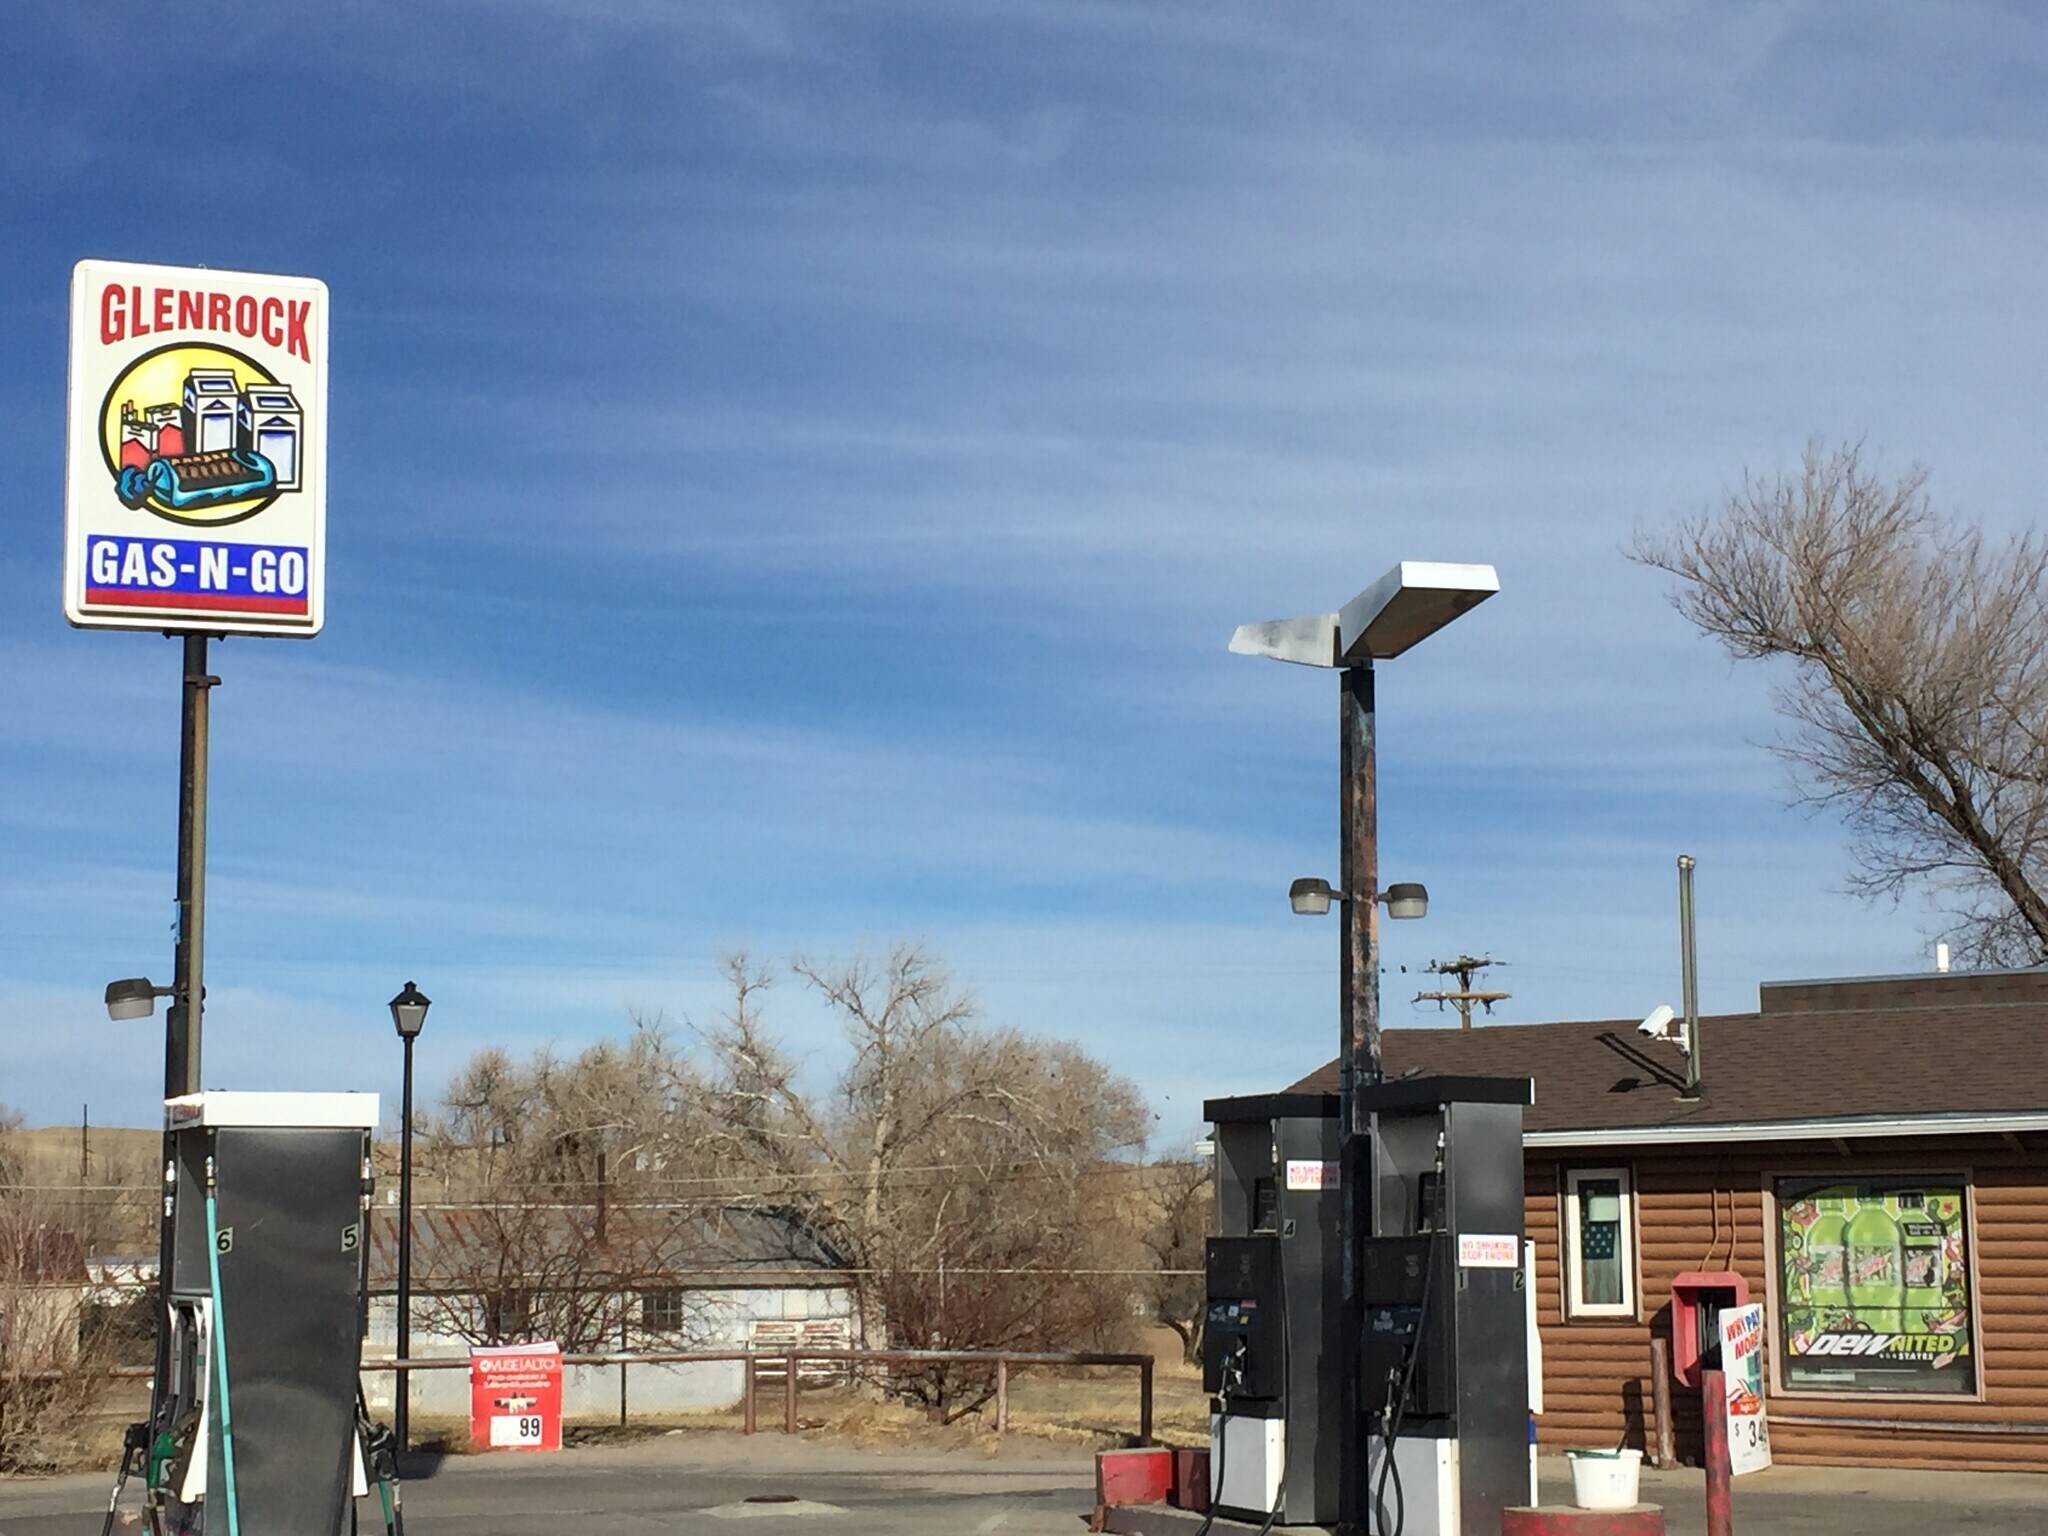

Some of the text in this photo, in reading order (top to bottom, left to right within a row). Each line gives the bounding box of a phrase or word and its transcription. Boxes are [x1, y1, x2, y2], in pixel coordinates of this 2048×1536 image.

[101, 283, 311, 364] GLENROCK
[92, 541, 305, 595] GAS-N-GO
[344, 1226, 357, 1248] 5
[1284, 1220, 1294, 1236] 4
[217, 1230, 231, 1252] 6
[1459, 1271, 1464, 1289] 1
[1515, 1270, 1524, 1289] 2
[1726, 1308, 1760, 1342] WHY PAY
[524, 1358, 556, 1371] ALTO
[519, 1418, 540, 1437] 99
